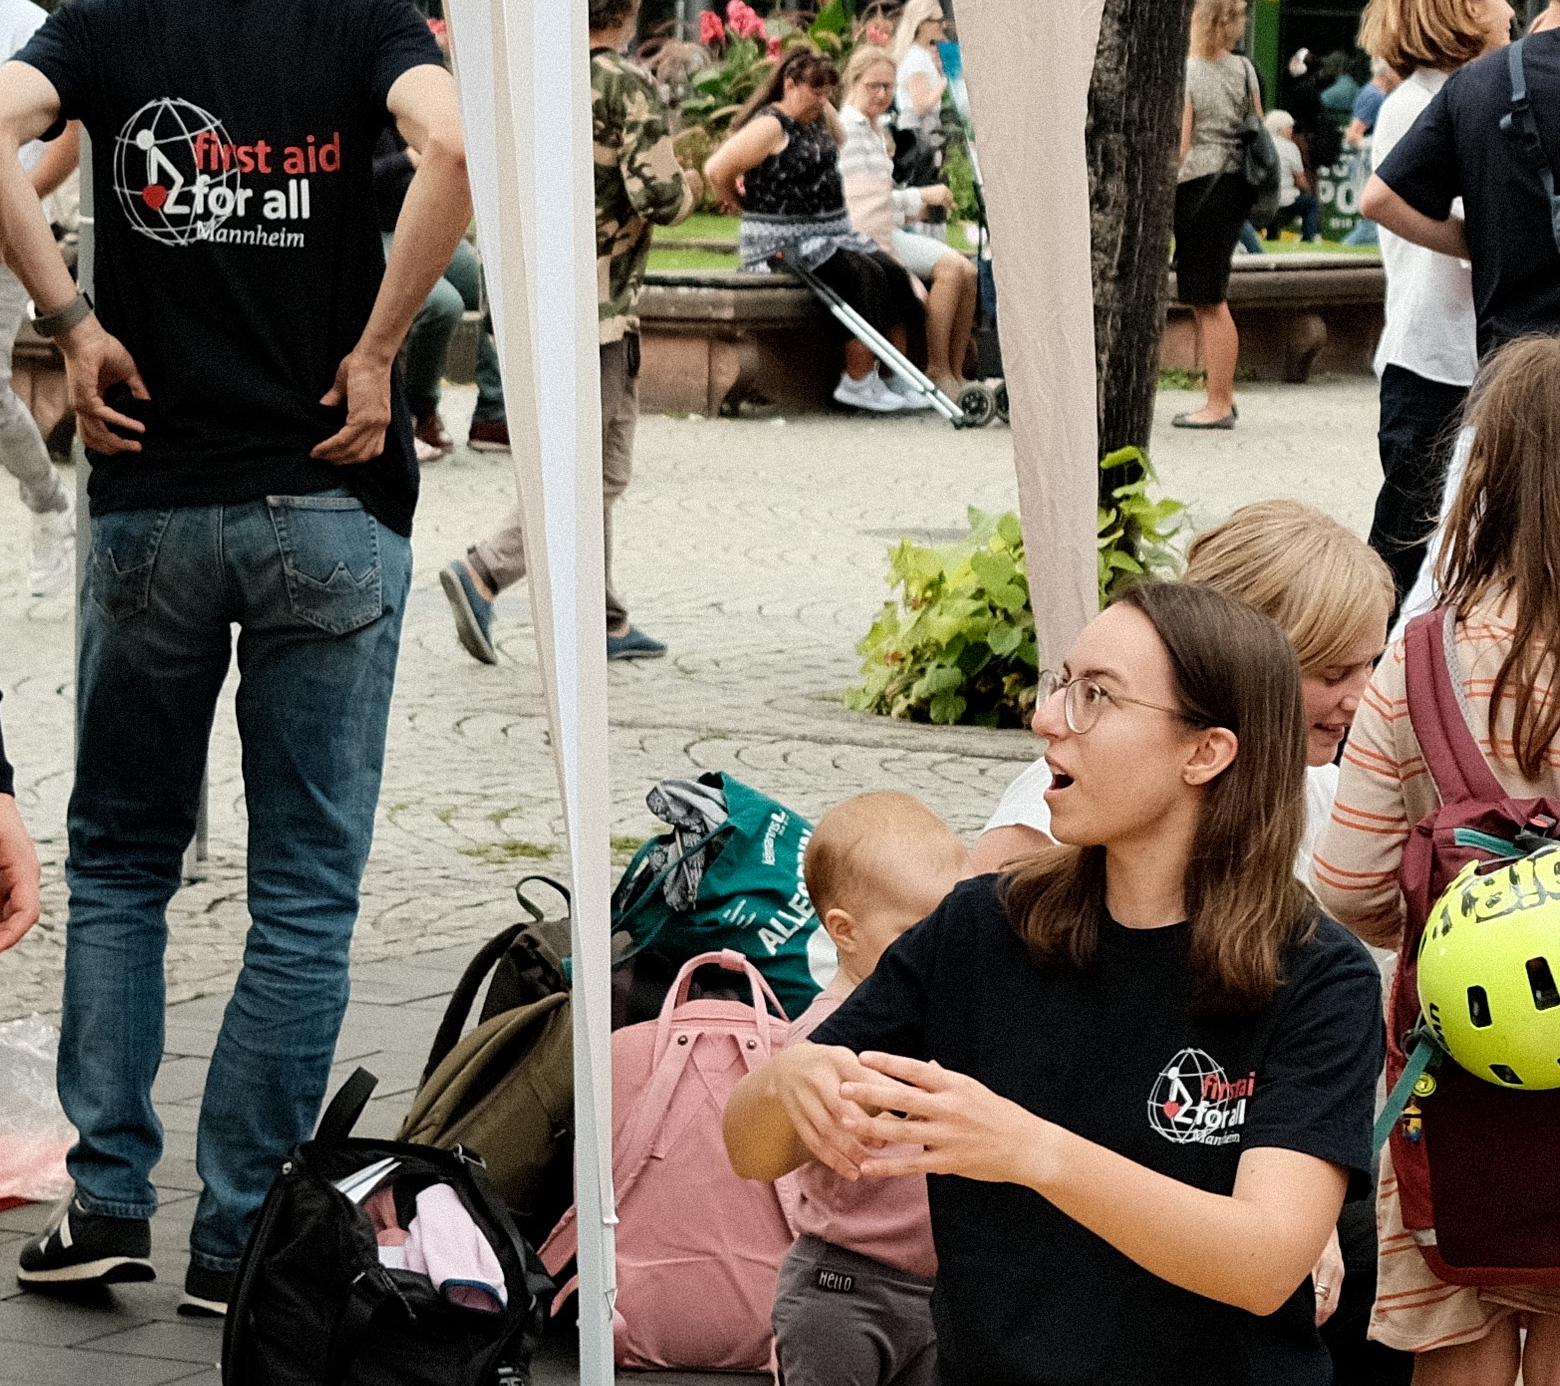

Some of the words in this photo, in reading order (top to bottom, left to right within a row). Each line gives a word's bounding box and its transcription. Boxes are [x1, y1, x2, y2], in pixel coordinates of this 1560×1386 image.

[195, 132, 272, 174] first
[283, 132, 340, 174] aid
[192, 174, 253, 217] for
[263, 178, 310, 220] all
[196, 220, 305, 248] Mannheim
